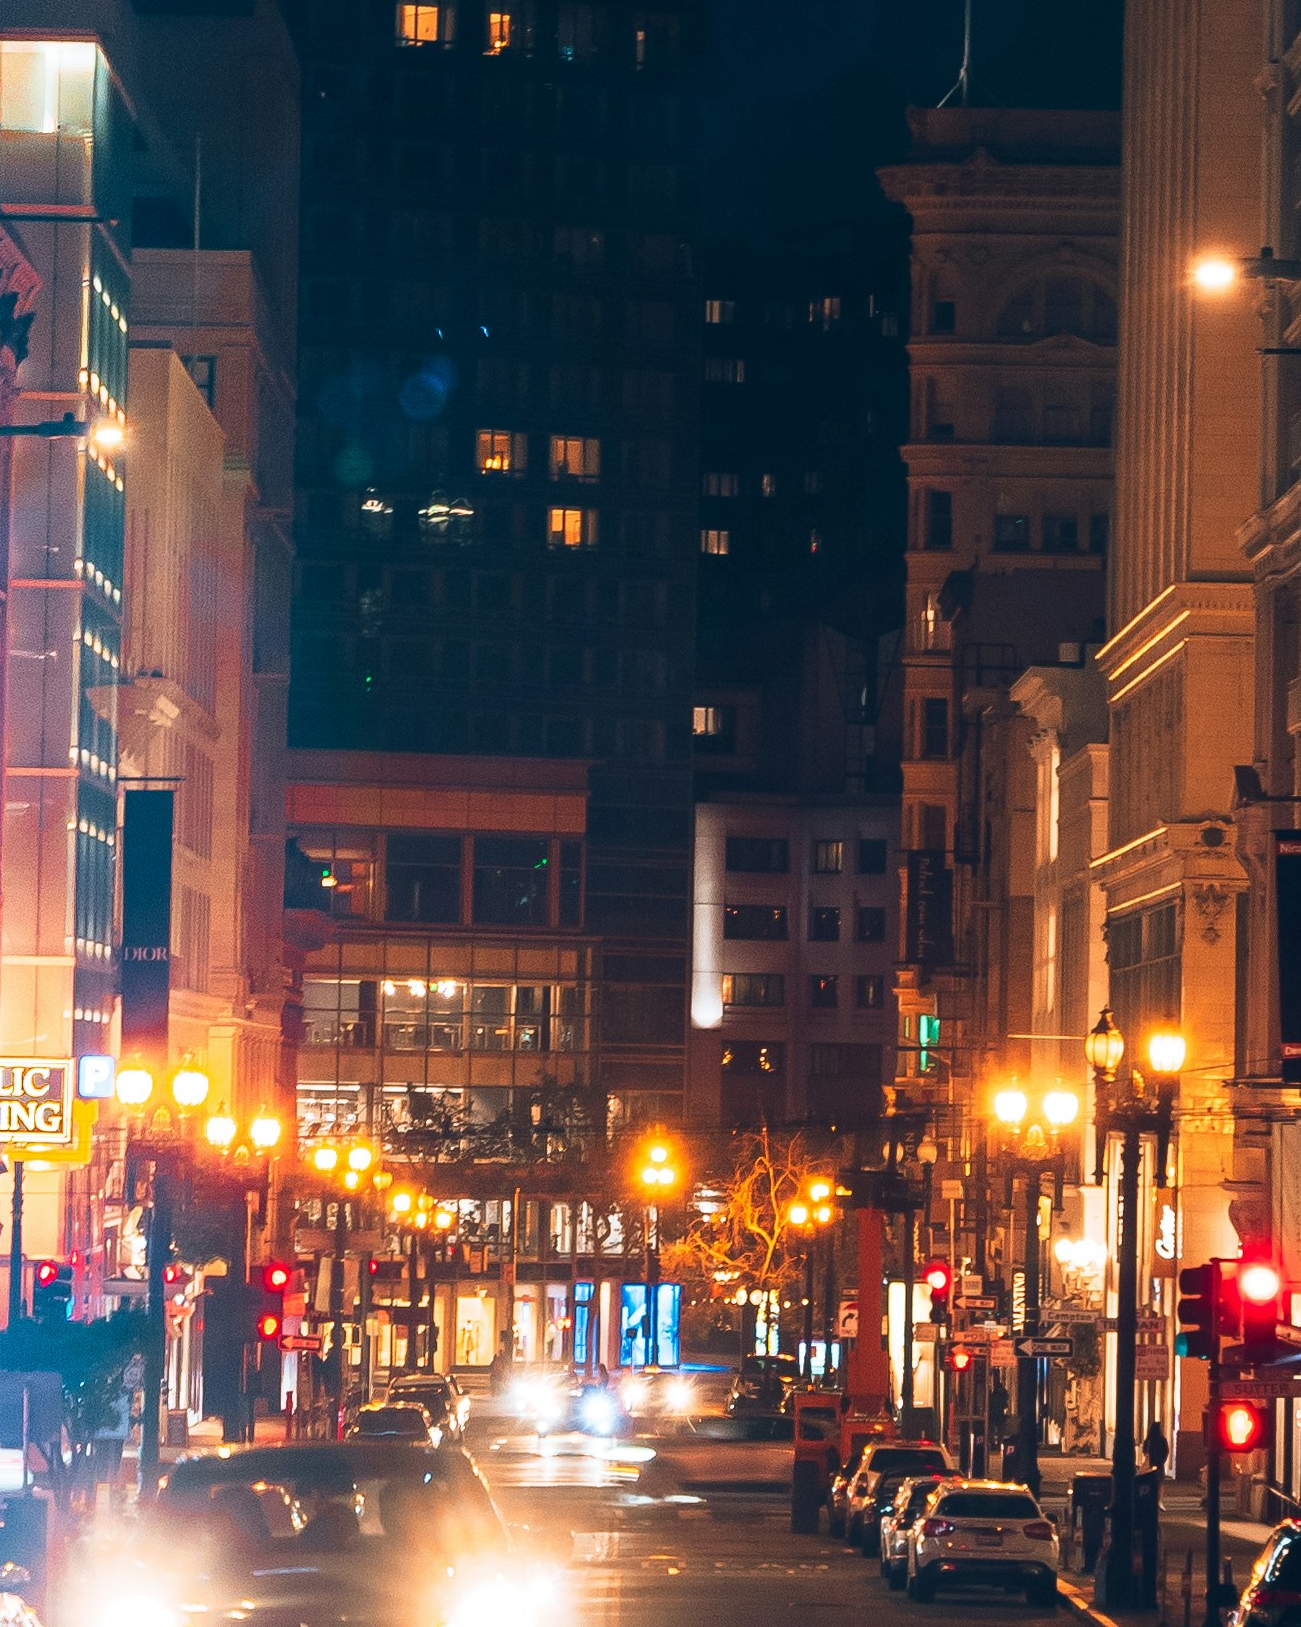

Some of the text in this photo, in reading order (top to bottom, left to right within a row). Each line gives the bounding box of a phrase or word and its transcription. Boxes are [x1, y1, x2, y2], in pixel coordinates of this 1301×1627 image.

[124, 946, 169, 961] DIOR
[84, 1058, 110, 1095] P
[1048, 1312, 1092, 1322] Campton
[1235, 1381, 1285, 1394] SUTTER
